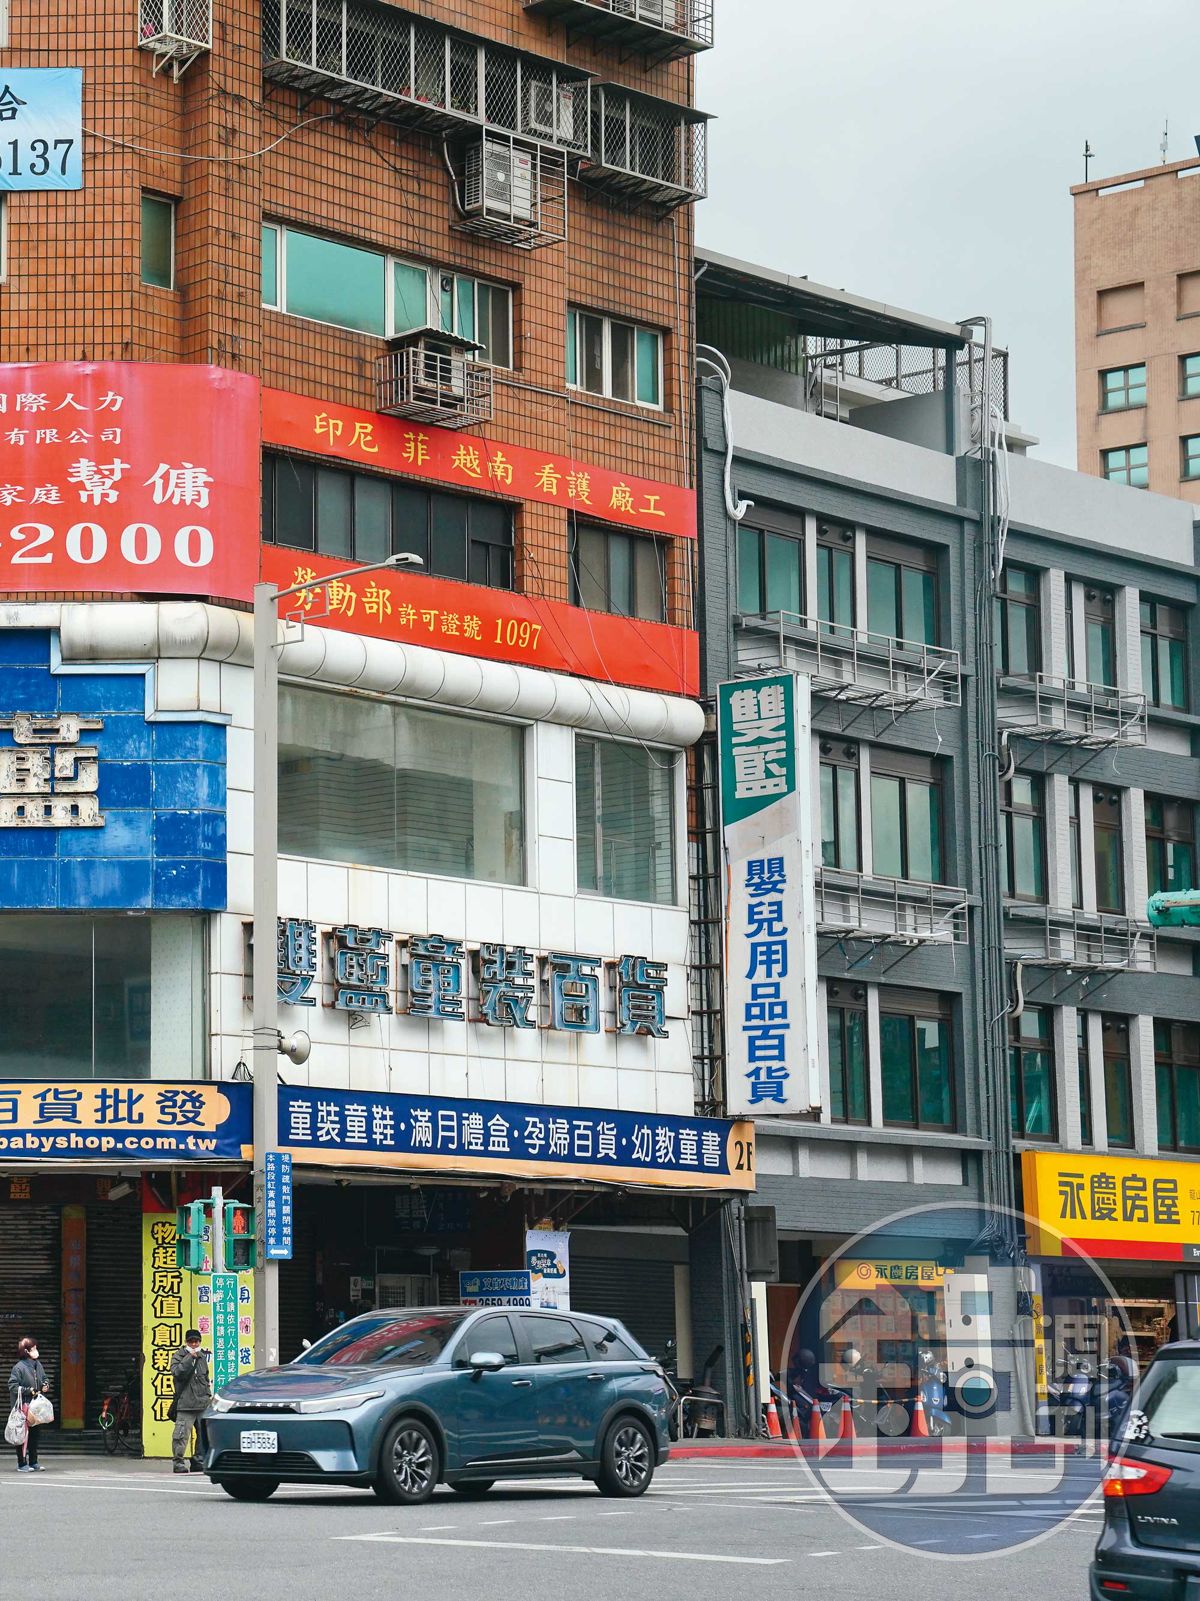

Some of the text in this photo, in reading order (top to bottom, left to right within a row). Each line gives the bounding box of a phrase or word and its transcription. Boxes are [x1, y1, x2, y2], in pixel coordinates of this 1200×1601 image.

[66, 456, 215, 509] 幫傭
[313, 411, 666, 518] 印尼 菲 越南 看護 廠工
[290, 564, 542, 651] 勞動部 許可證號 1097
[729, 683, 788, 799] 雙藍
[742, 856, 790, 1106] 嬰兒用品百貨
[734, 1140, 754, 1172] 2F
[1058, 1171, 1181, 1225] 永慶房屋
[151, 1221, 182, 1318] 物超所值
